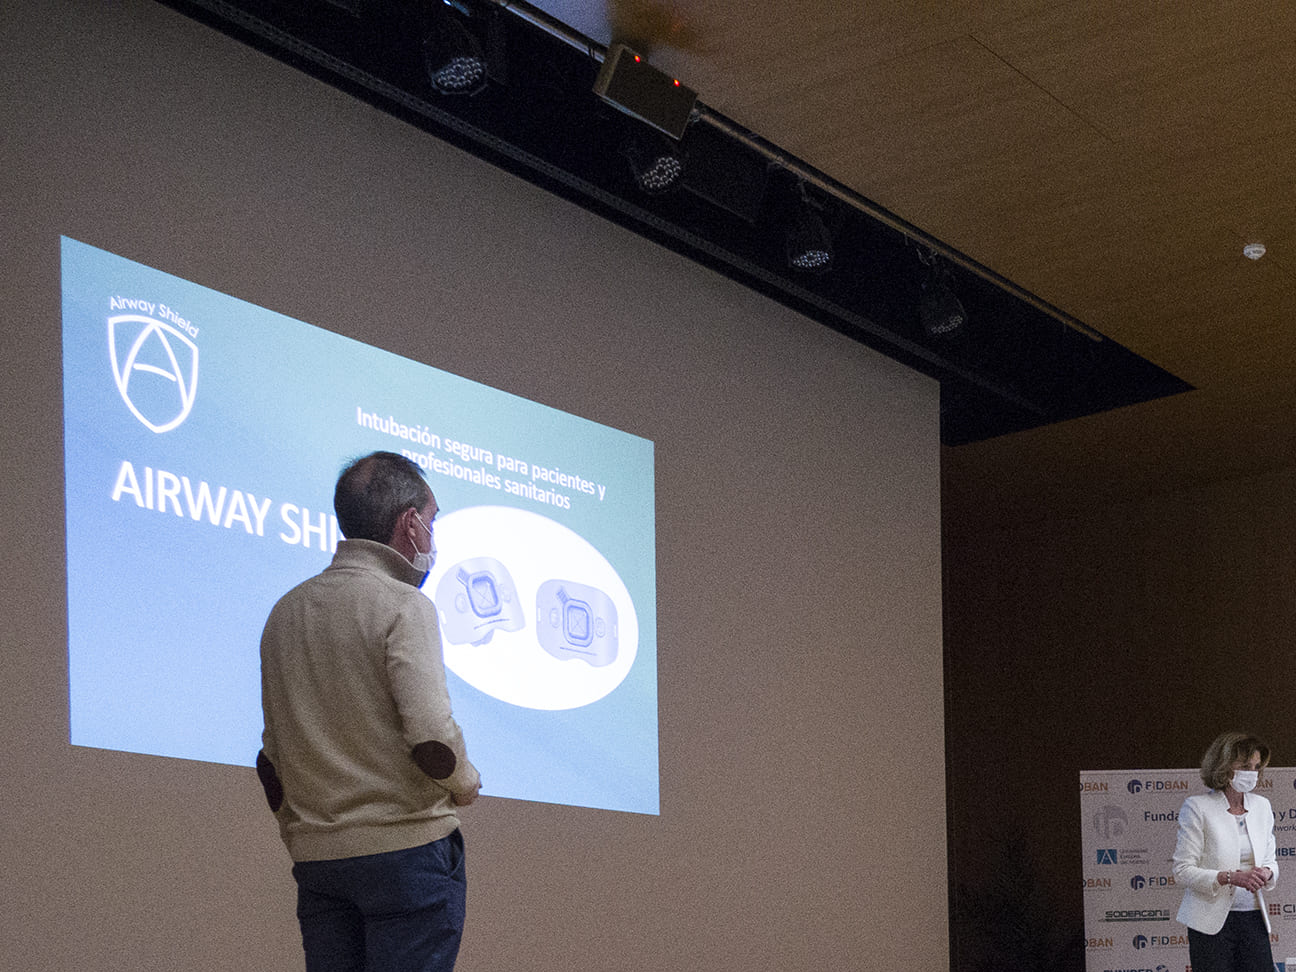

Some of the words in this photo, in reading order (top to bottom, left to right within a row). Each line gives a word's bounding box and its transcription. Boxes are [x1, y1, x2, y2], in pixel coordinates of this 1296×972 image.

[110, 295, 155, 315] Airway
[159, 303, 200, 338] Shield
[356, 406, 441, 450] Intubación
[444, 436, 493, 465] segura
[497, 453, 529, 476] para
[531, 463, 595, 495] pacientes
[598, 485, 606, 501] y
[402, 448, 501, 490] profesionales
[504, 477, 571, 510] sanitarios
[111, 459, 272, 537] AIRWAY
[280, 502, 346, 554] SHI
[1145, 780, 1189, 790] FIDBAN
[1279, 811, 1286, 822] y
[1149, 876, 1176, 886] FIDB
